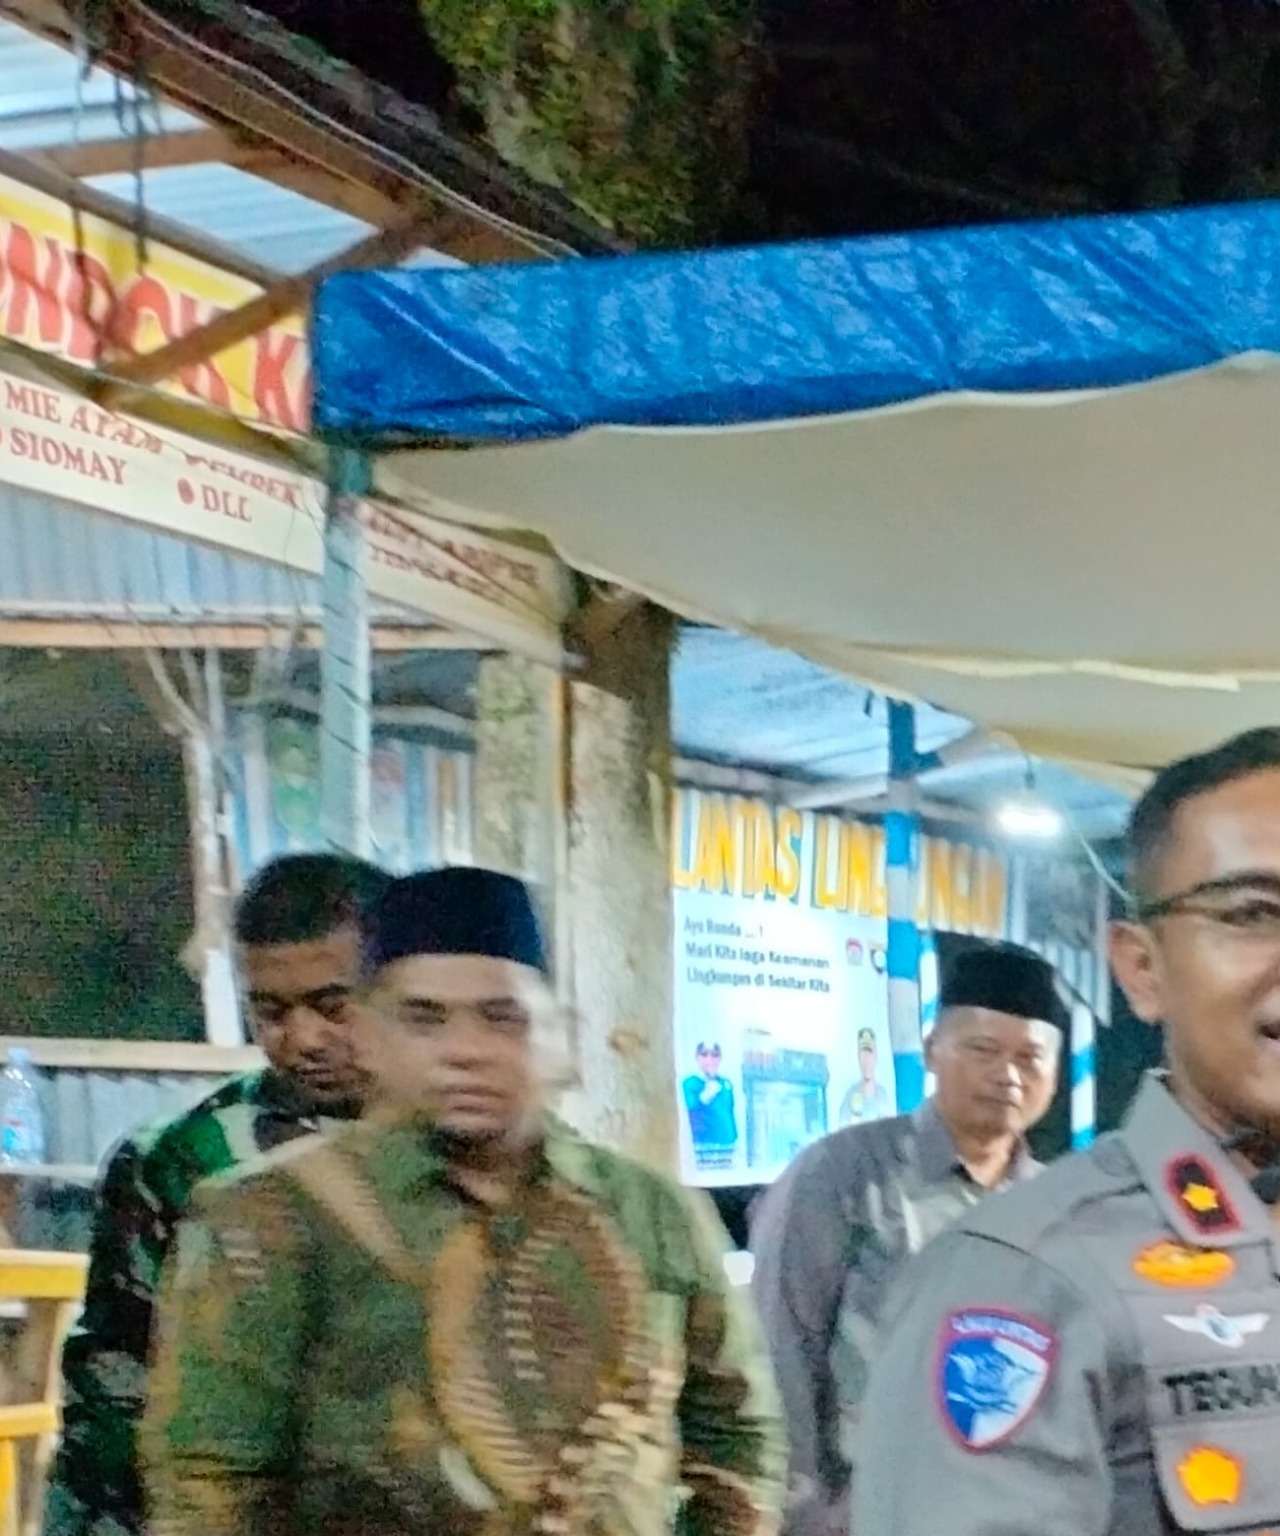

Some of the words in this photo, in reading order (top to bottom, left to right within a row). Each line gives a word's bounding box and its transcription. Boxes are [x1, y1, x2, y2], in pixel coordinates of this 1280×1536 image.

[4, 380, 62, 425] MIE
[10, 427, 127, 486] SIOMAY
[202, 483, 252, 523] DLL
[715, 944, 737, 960] Kita
[769, 951, 830, 969] Keamanan
